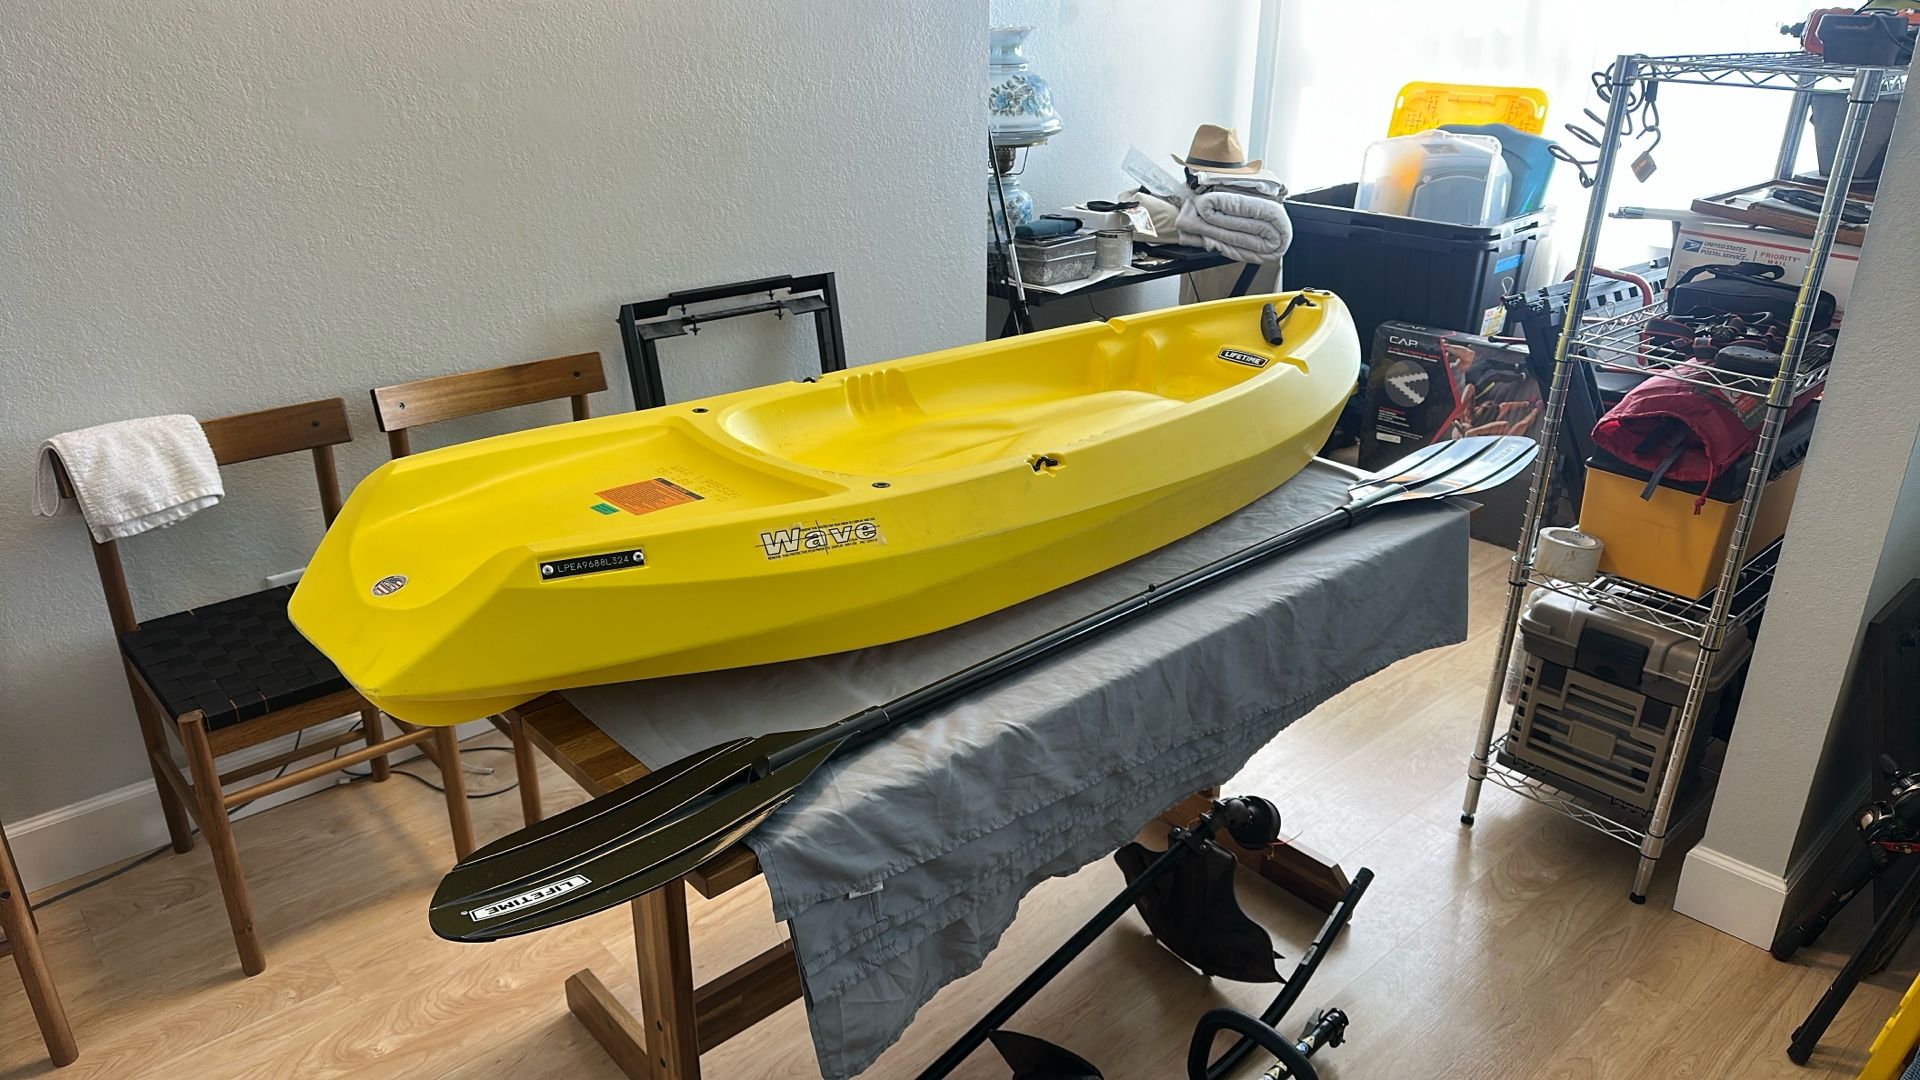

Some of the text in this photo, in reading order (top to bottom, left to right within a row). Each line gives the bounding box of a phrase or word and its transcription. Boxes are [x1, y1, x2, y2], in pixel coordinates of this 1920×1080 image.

[1704, 241, 1747, 252] UNITED STATES
[1701, 249, 1747, 261] POSTAL SERVICE
[1760, 251, 1798, 262] PRIORITY
[1389, 335, 1418, 346] CAP
[1224, 351, 1262, 365] LIFETIME
[761, 522, 877, 556] Wave
[557, 555, 629, 573] LPEA9688L324
[485, 881, 574, 915] LIFETIME
